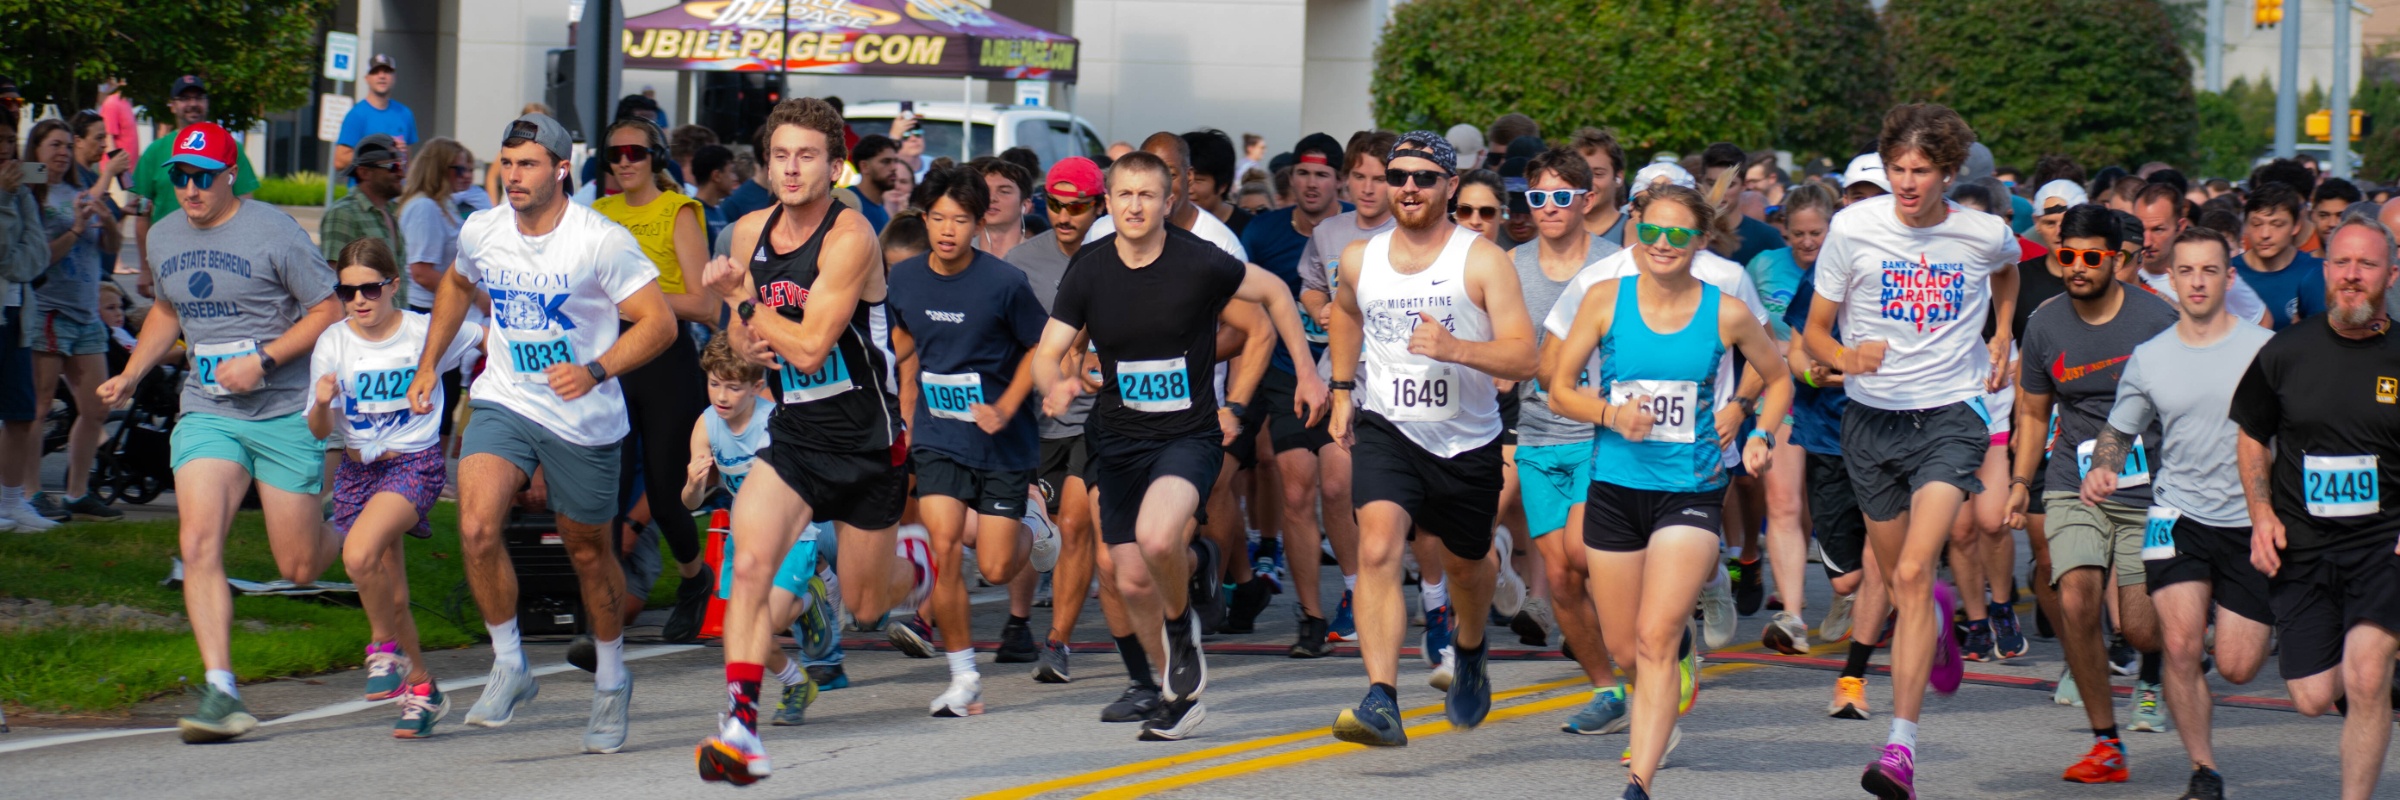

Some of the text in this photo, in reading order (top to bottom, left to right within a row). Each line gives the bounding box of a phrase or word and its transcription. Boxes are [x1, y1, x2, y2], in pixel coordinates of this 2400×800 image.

[180, 249, 207, 271] STATE
[208, 249, 252, 279] BEHREND
[1882, 261, 1907, 269] BANK
[484, 268, 569, 289] LECOM
[1881, 269, 1965, 289] CHICAGO
[1388, 296, 1452, 309] MIGHTY FINE
[1880, 288, 1964, 303] MARATHON
[174, 301, 243, 318] BASEBALL
[514, 340, 571, 371] 1833
[358, 368, 417, 400] 2422
[1123, 372, 1185, 400] 2438
[1393, 377, 1448, 408] 1649
[929, 385, 979, 411] 1965
[2309, 471, 2373, 502] 2449
